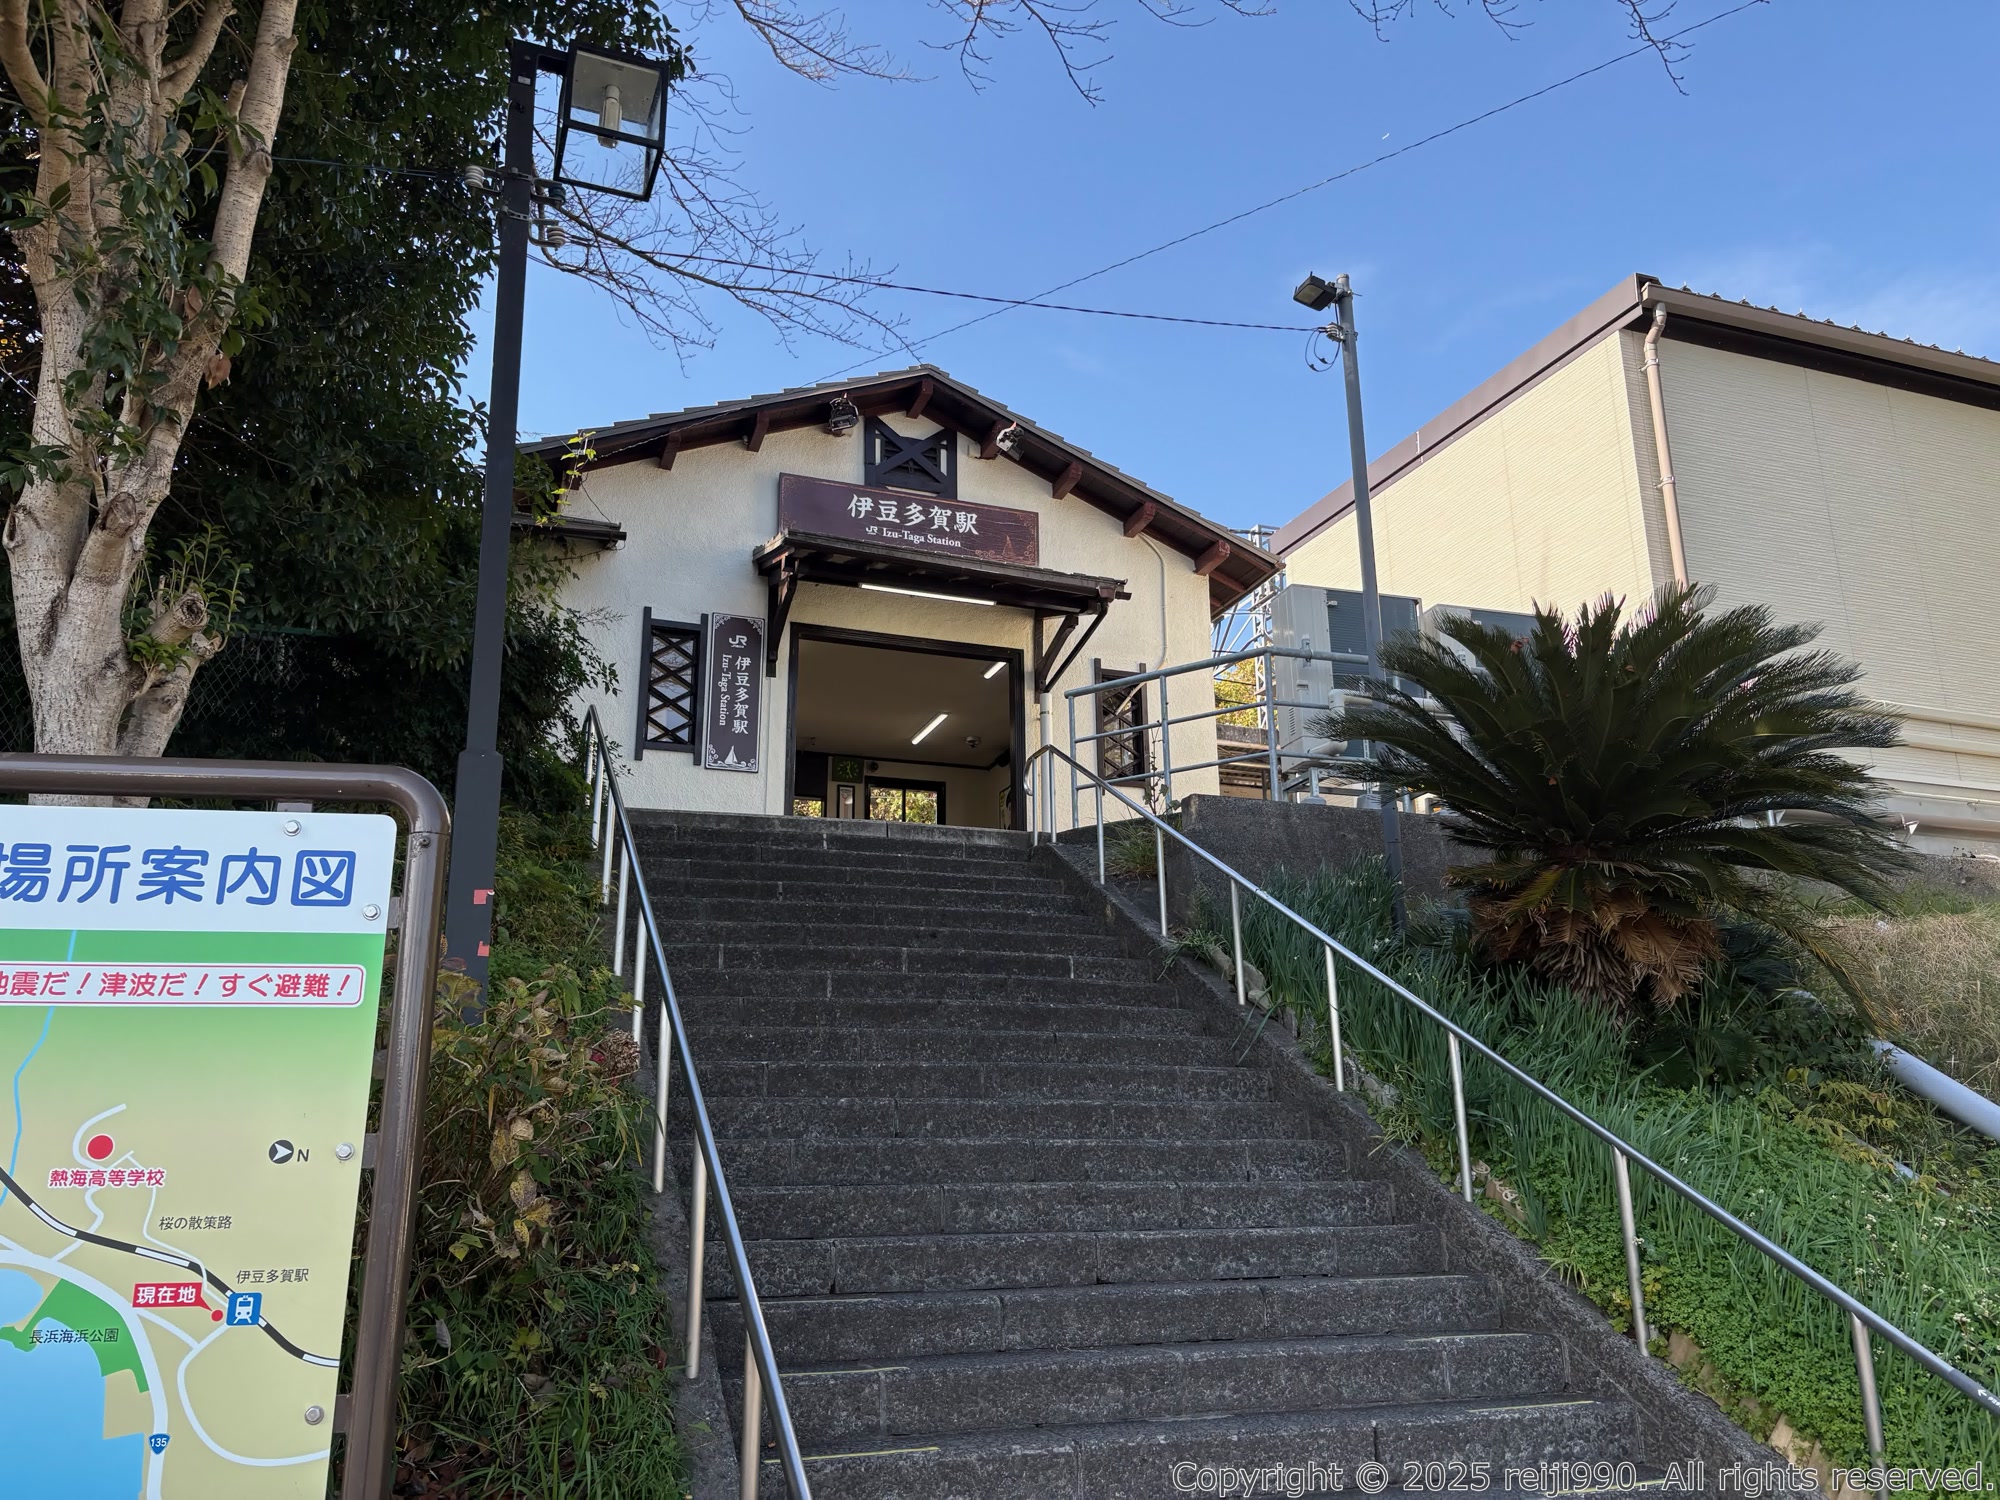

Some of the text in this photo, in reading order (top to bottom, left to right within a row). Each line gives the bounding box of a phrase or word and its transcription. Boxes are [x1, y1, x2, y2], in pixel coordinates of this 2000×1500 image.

[847, 493, 979, 536] 伊豆多賀駅
[865, 525, 961, 547] JR Izu-Taga Station
[729, 634, 748, 646] JR
[717, 653, 732, 726] Izu-Taga Station
[732, 655, 751, 735] 伊豆多賀駅
[0, 842, 357, 907] 場所案内図
[296, 1149, 310, 1162] N
[49, 1168, 165, 1188] 熱海高等学校
[158, 1215, 232, 1231] 桜の散策路
[236, 1268, 309, 1284] 伊豆多賀駅
[136, 1285, 196, 1305] 現在地
[29, 1328, 119, 1344] 長浜海浜公園
[151, 1436, 167, 1448] 135
